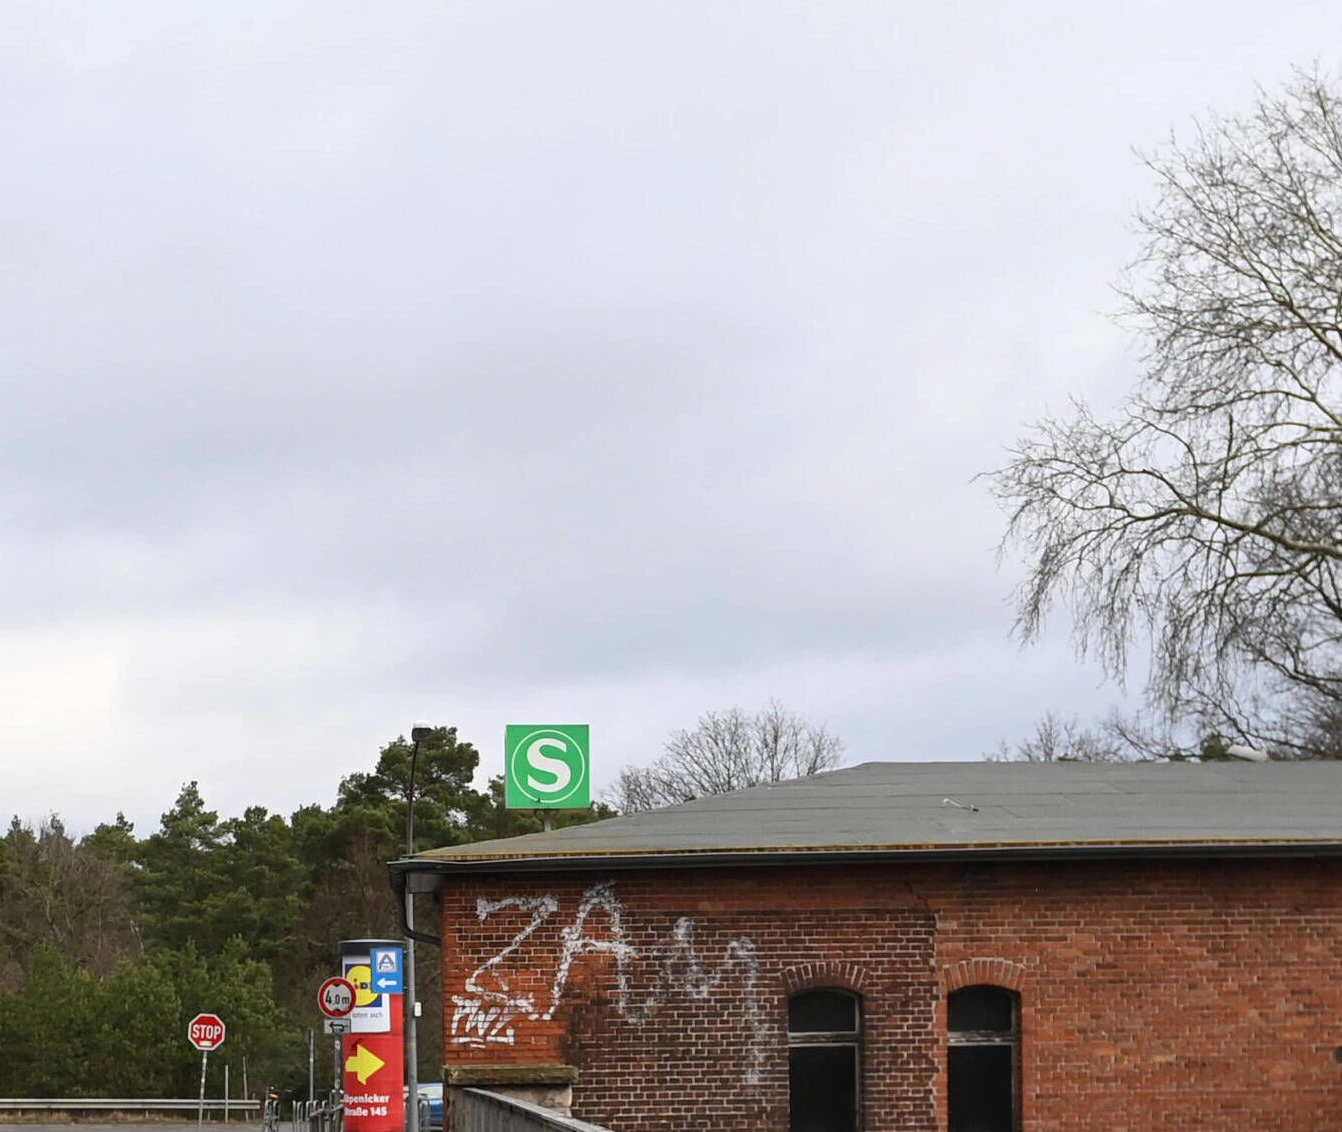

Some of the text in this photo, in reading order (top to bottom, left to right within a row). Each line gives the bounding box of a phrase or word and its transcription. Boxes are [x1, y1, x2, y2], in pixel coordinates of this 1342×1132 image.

[526, 737, 572, 793] S
[191, 1023, 222, 1040] STOP
[370, 1106, 388, 1116] 145
